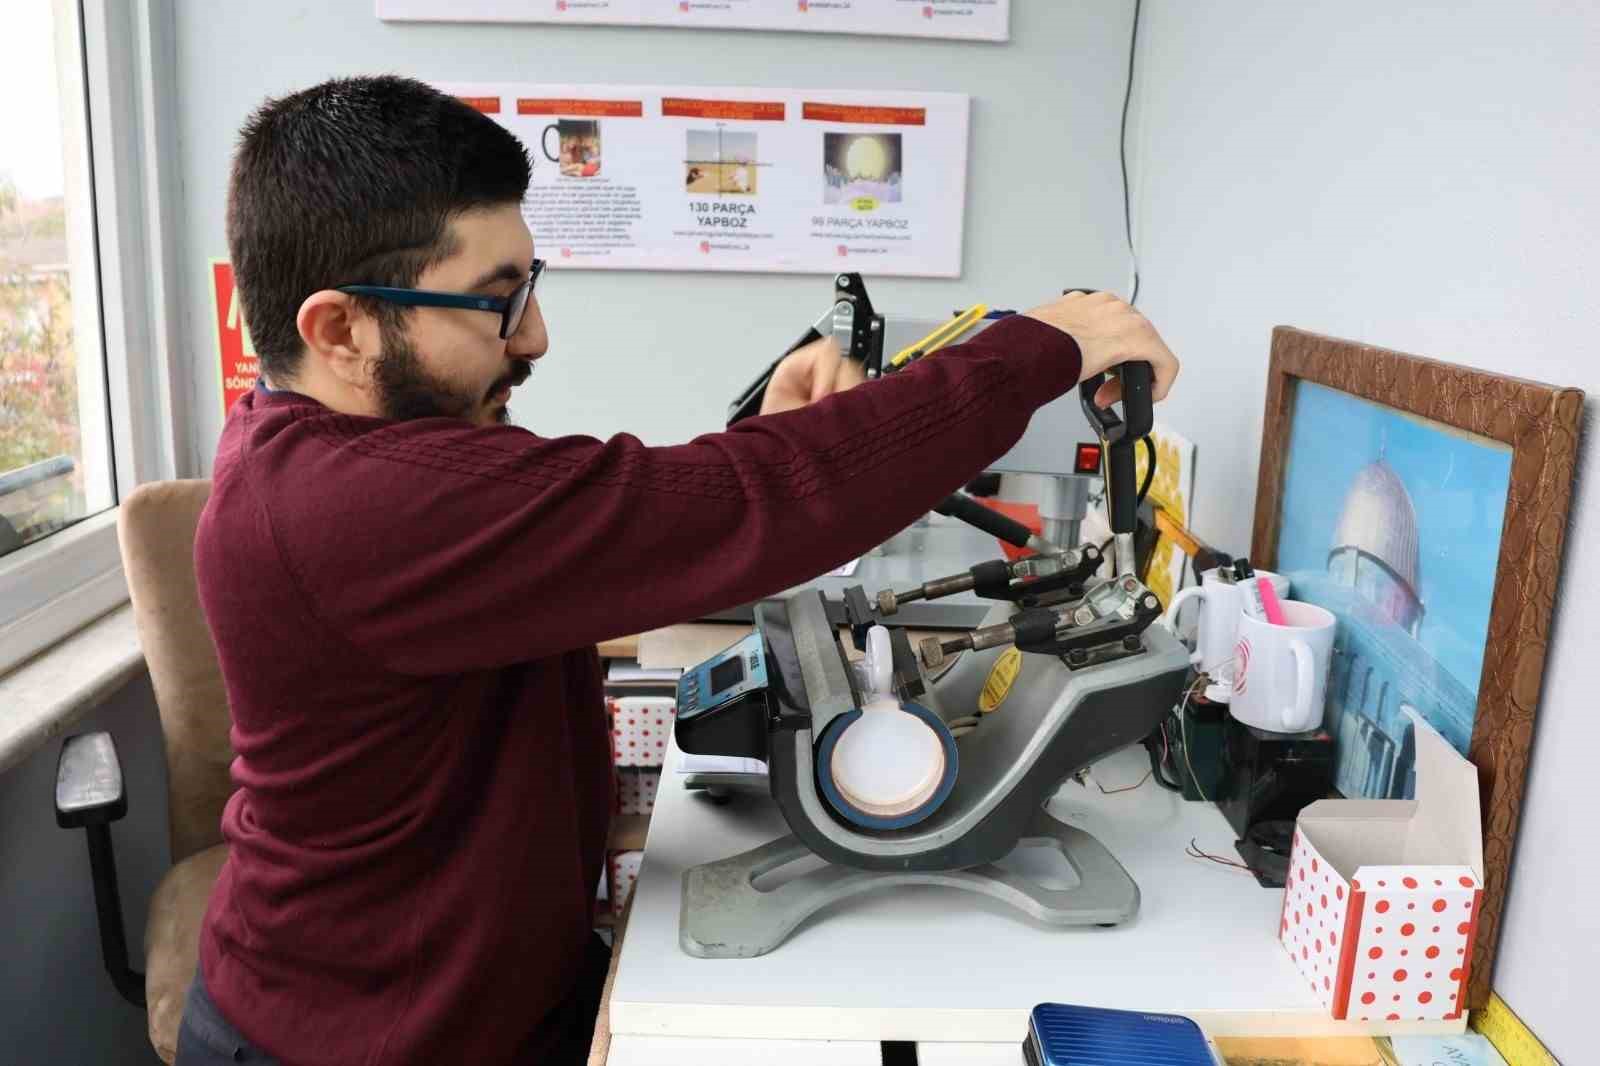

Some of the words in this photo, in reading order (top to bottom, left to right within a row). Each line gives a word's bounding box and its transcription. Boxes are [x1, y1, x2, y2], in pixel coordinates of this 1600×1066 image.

[689, 202, 710, 213] 130
[712, 202, 756, 216] PARÇA
[697, 216, 748, 229] YAPBOZ
[235, 361, 260, 374] YAN
